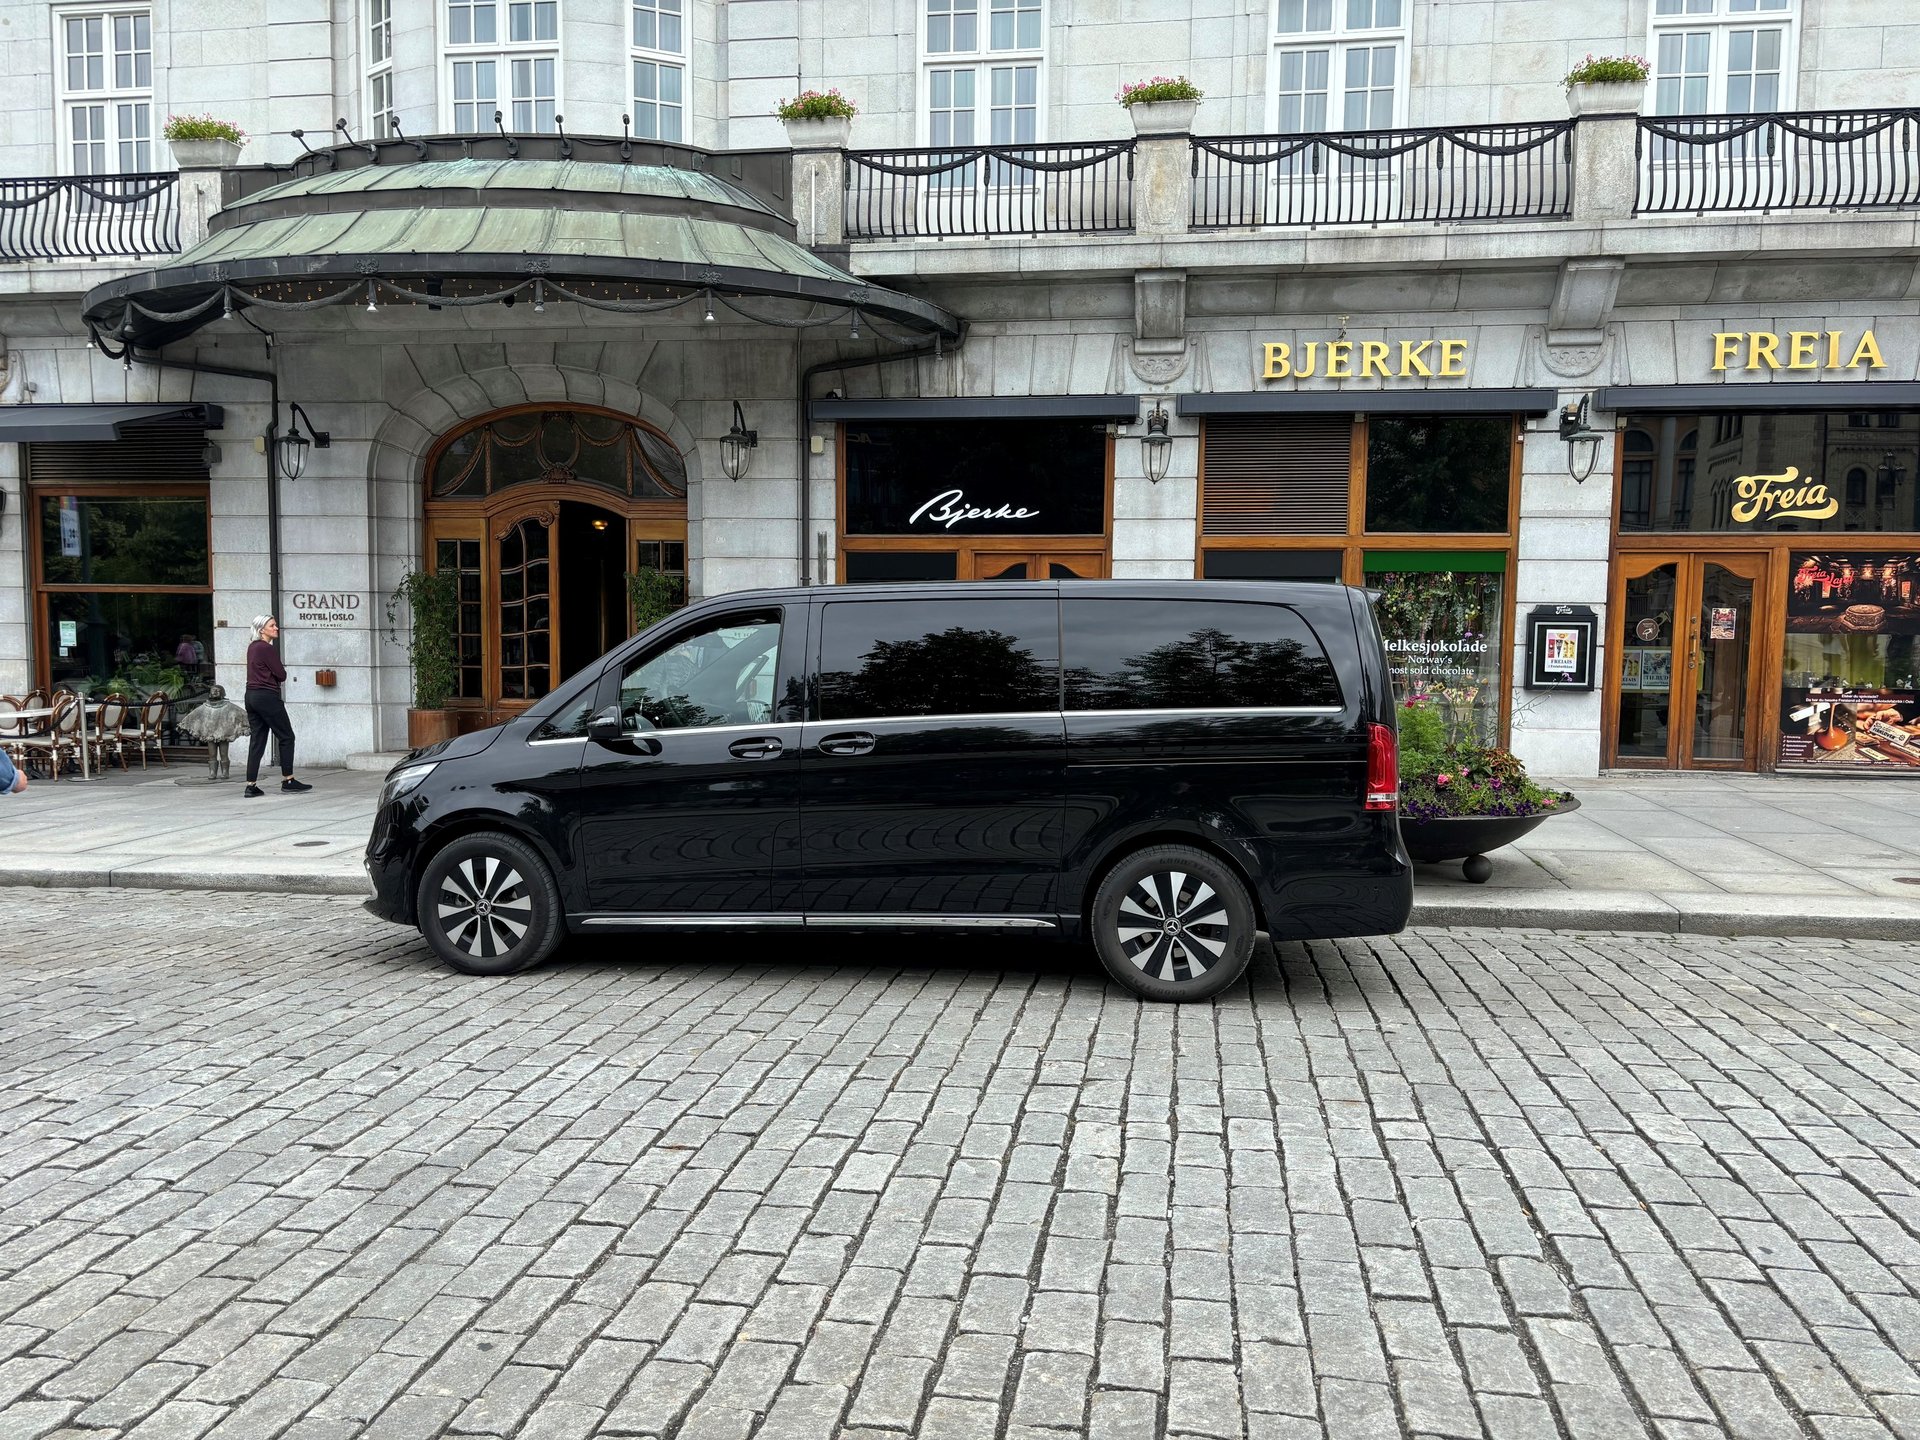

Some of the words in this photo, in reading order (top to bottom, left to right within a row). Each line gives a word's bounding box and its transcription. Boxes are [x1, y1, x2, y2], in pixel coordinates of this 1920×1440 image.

[1261, 339, 1468, 378] BJERKE
[1711, 330, 1888, 370] FREIA
[909, 489, 1040, 528] Bjerke
[1731, 466, 1839, 523] Freia
[292, 593, 360, 609] GRAND
[1410, 666, 1429, 675] sold
[1431, 666, 1475, 675] chocolate
